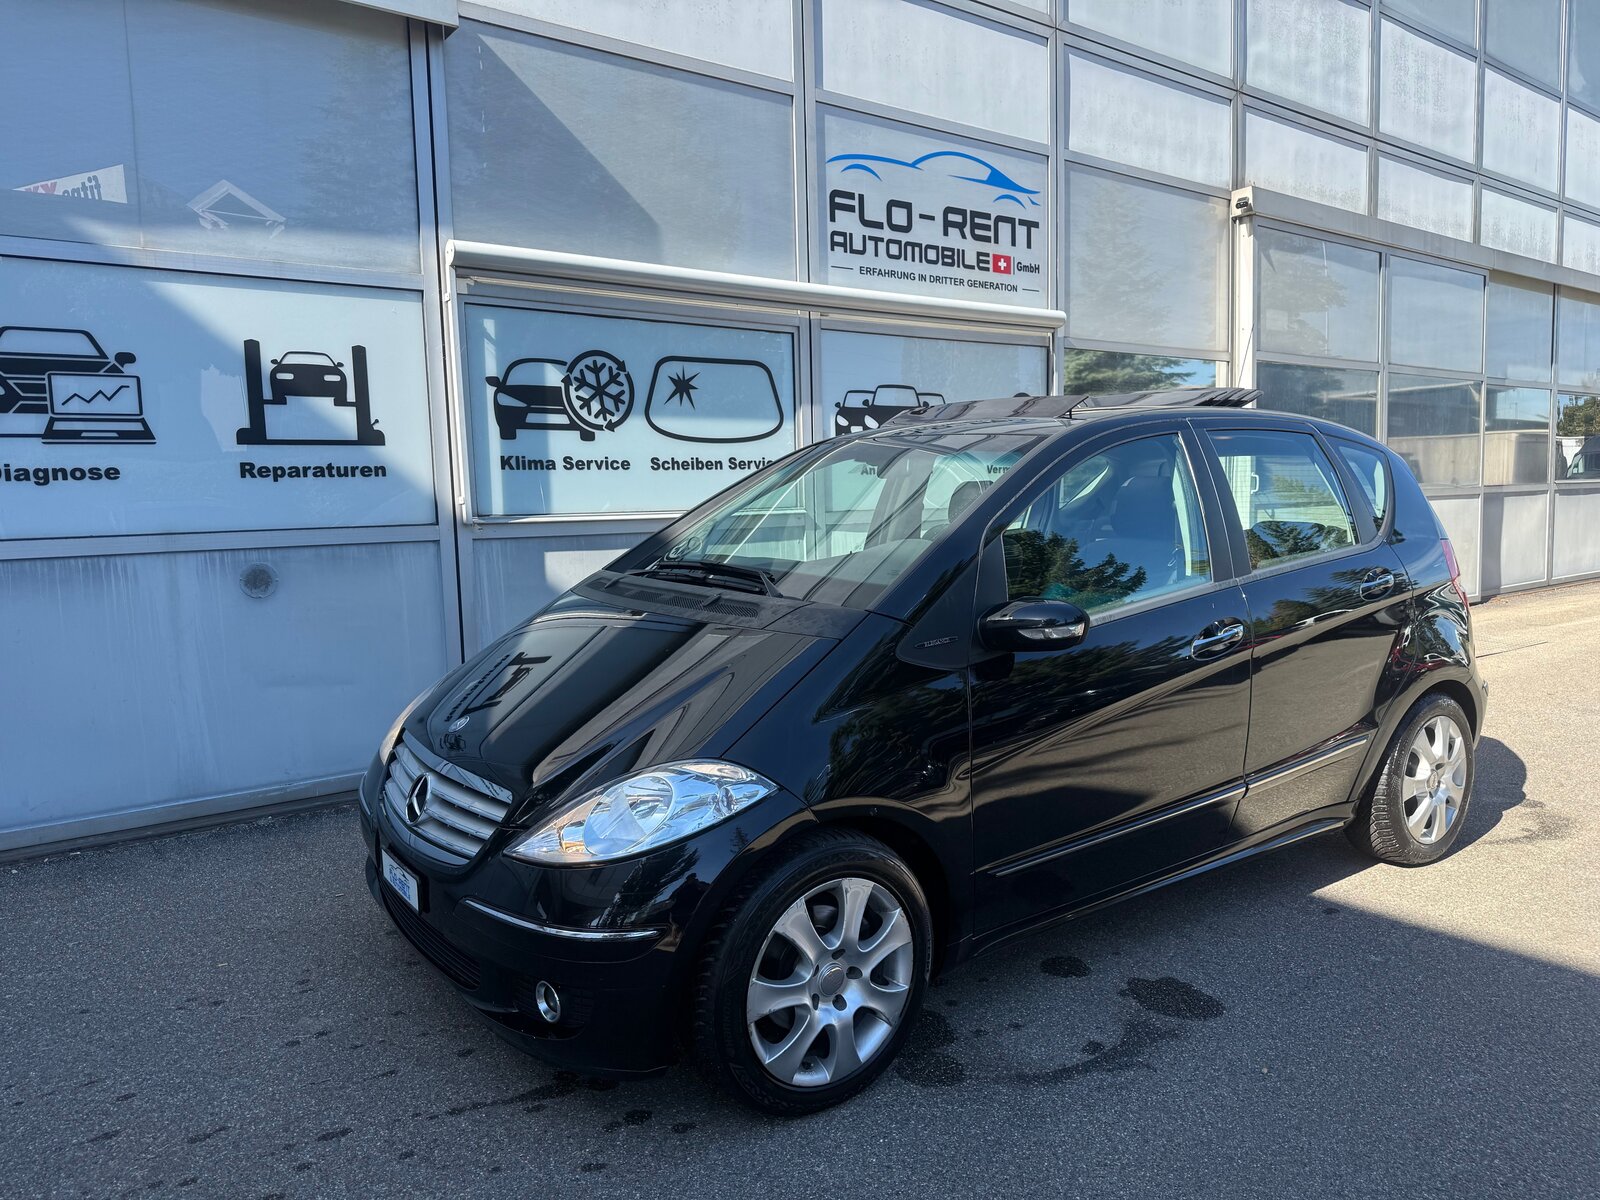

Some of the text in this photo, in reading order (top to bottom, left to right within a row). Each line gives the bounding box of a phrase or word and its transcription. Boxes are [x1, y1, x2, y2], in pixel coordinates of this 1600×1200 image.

[830, 230, 1041, 274] AUTOMOBILE GmbH
[859, 265, 1018, 292] ERFAHRUNG IN DRITTER GENERATION
[239, 461, 387, 482] Reparaturen
[500, 455, 631, 471] Klima Service
[650, 456, 723, 471] Scheiben
[0, 463, 121, 486] iagnose
